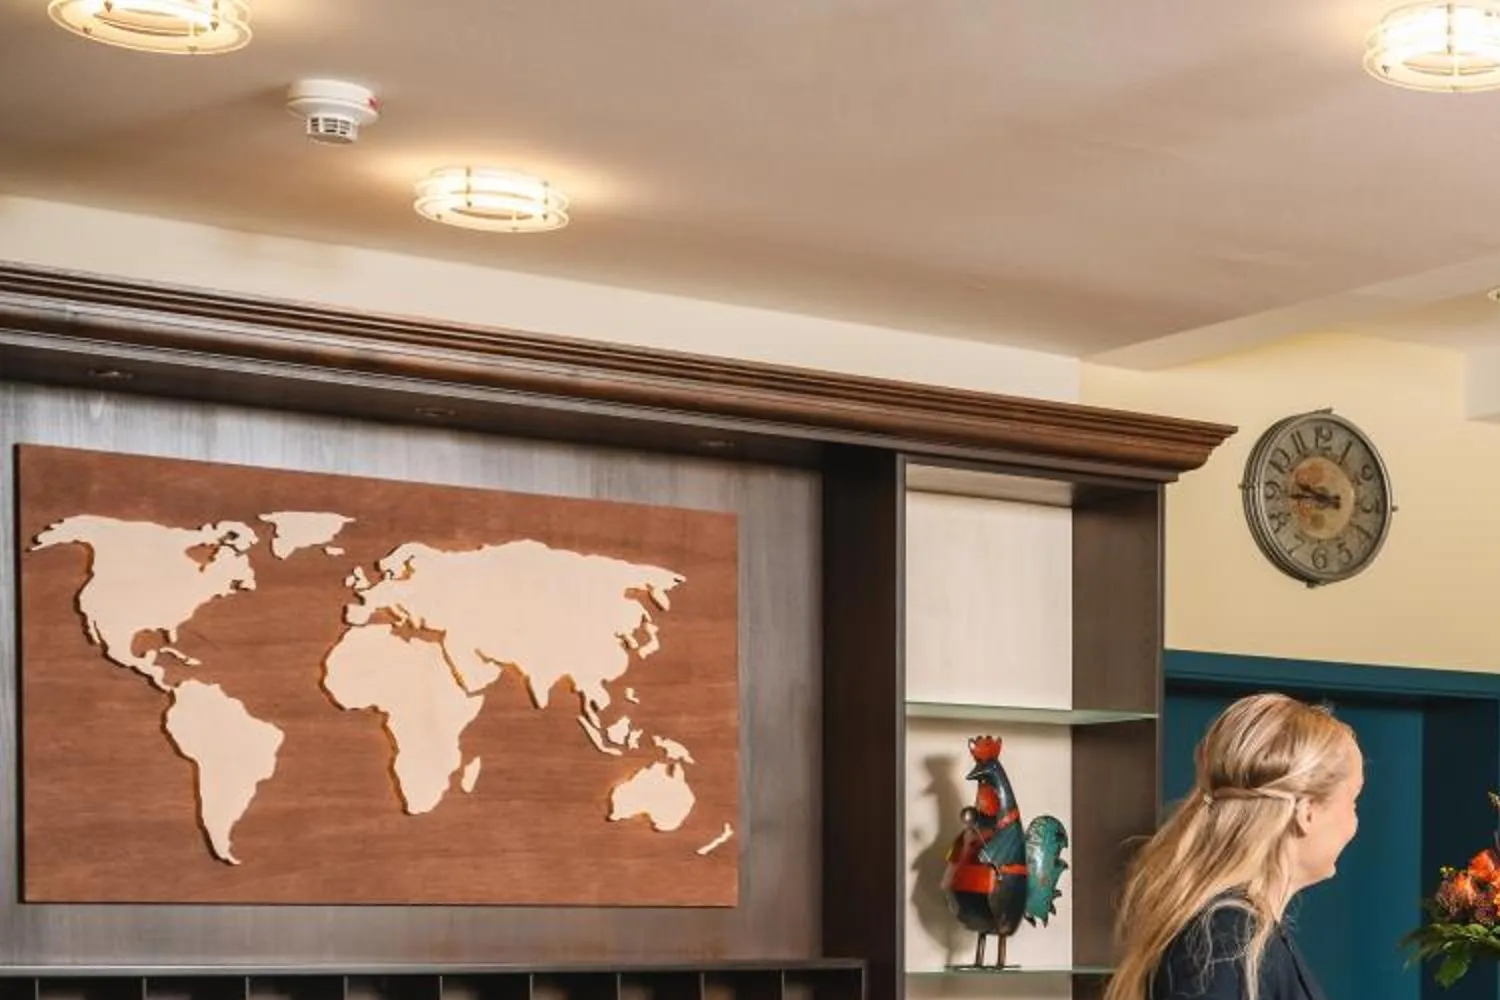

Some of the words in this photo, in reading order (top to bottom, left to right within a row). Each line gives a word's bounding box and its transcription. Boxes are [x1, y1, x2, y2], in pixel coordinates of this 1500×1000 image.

[1314, 425, 1333, 452] 12
[1338, 440, 1353, 466] 1
[1353, 463, 1374, 486] 2
[1264, 481, 1281, 500] 9
[1311, 547, 1328, 570] 6
[1337, 541, 1353, 562] 5
